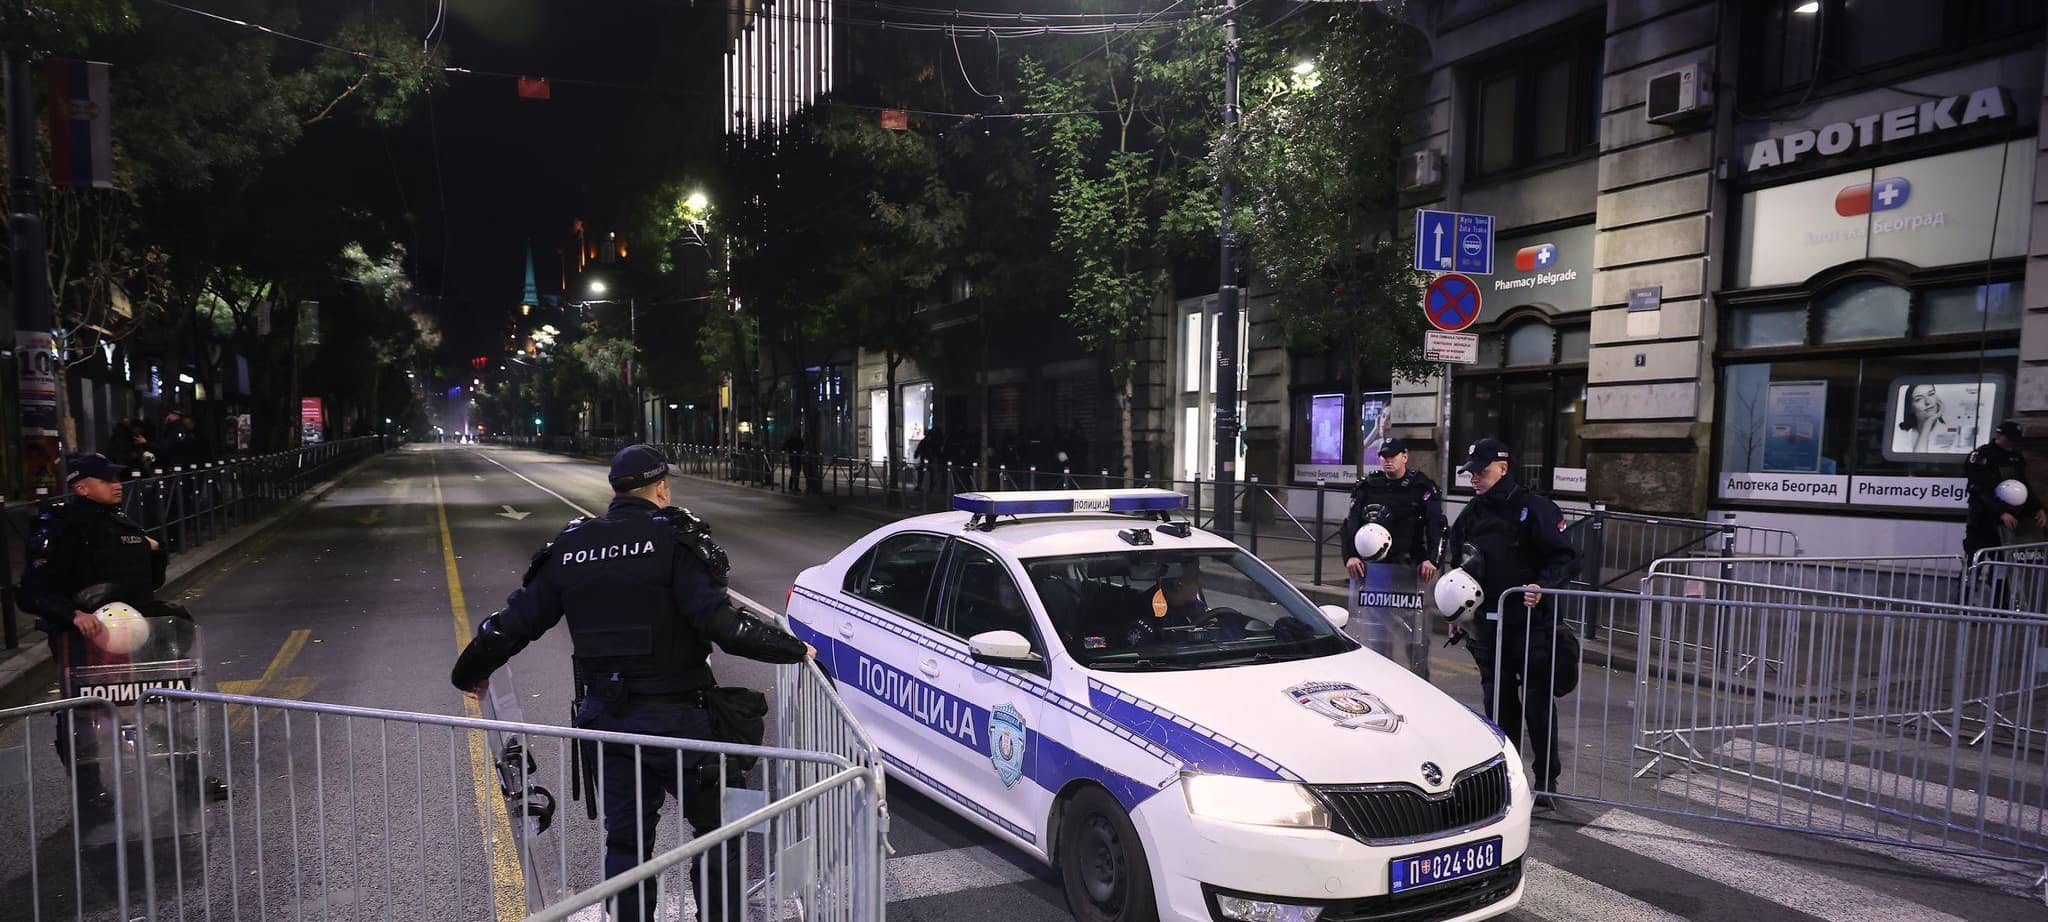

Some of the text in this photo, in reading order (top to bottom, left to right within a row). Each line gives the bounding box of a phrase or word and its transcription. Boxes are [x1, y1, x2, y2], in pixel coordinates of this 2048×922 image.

[1748, 86, 2005, 171] APOTEKA
[1873, 211, 1945, 235] Београд
[1495, 269, 1577, 290] Pharmacy Belgrade
[23, 350, 50, 377] 10
[1728, 479, 1837, 496] Апотека Београд
[1859, 483, 1928, 500] Pharmacy
[563, 541, 655, 565] POLICIJA
[1360, 592, 1422, 609] ПОЛИЦИЈА
[859, 656, 977, 746] ПОЛИЦИЈА
